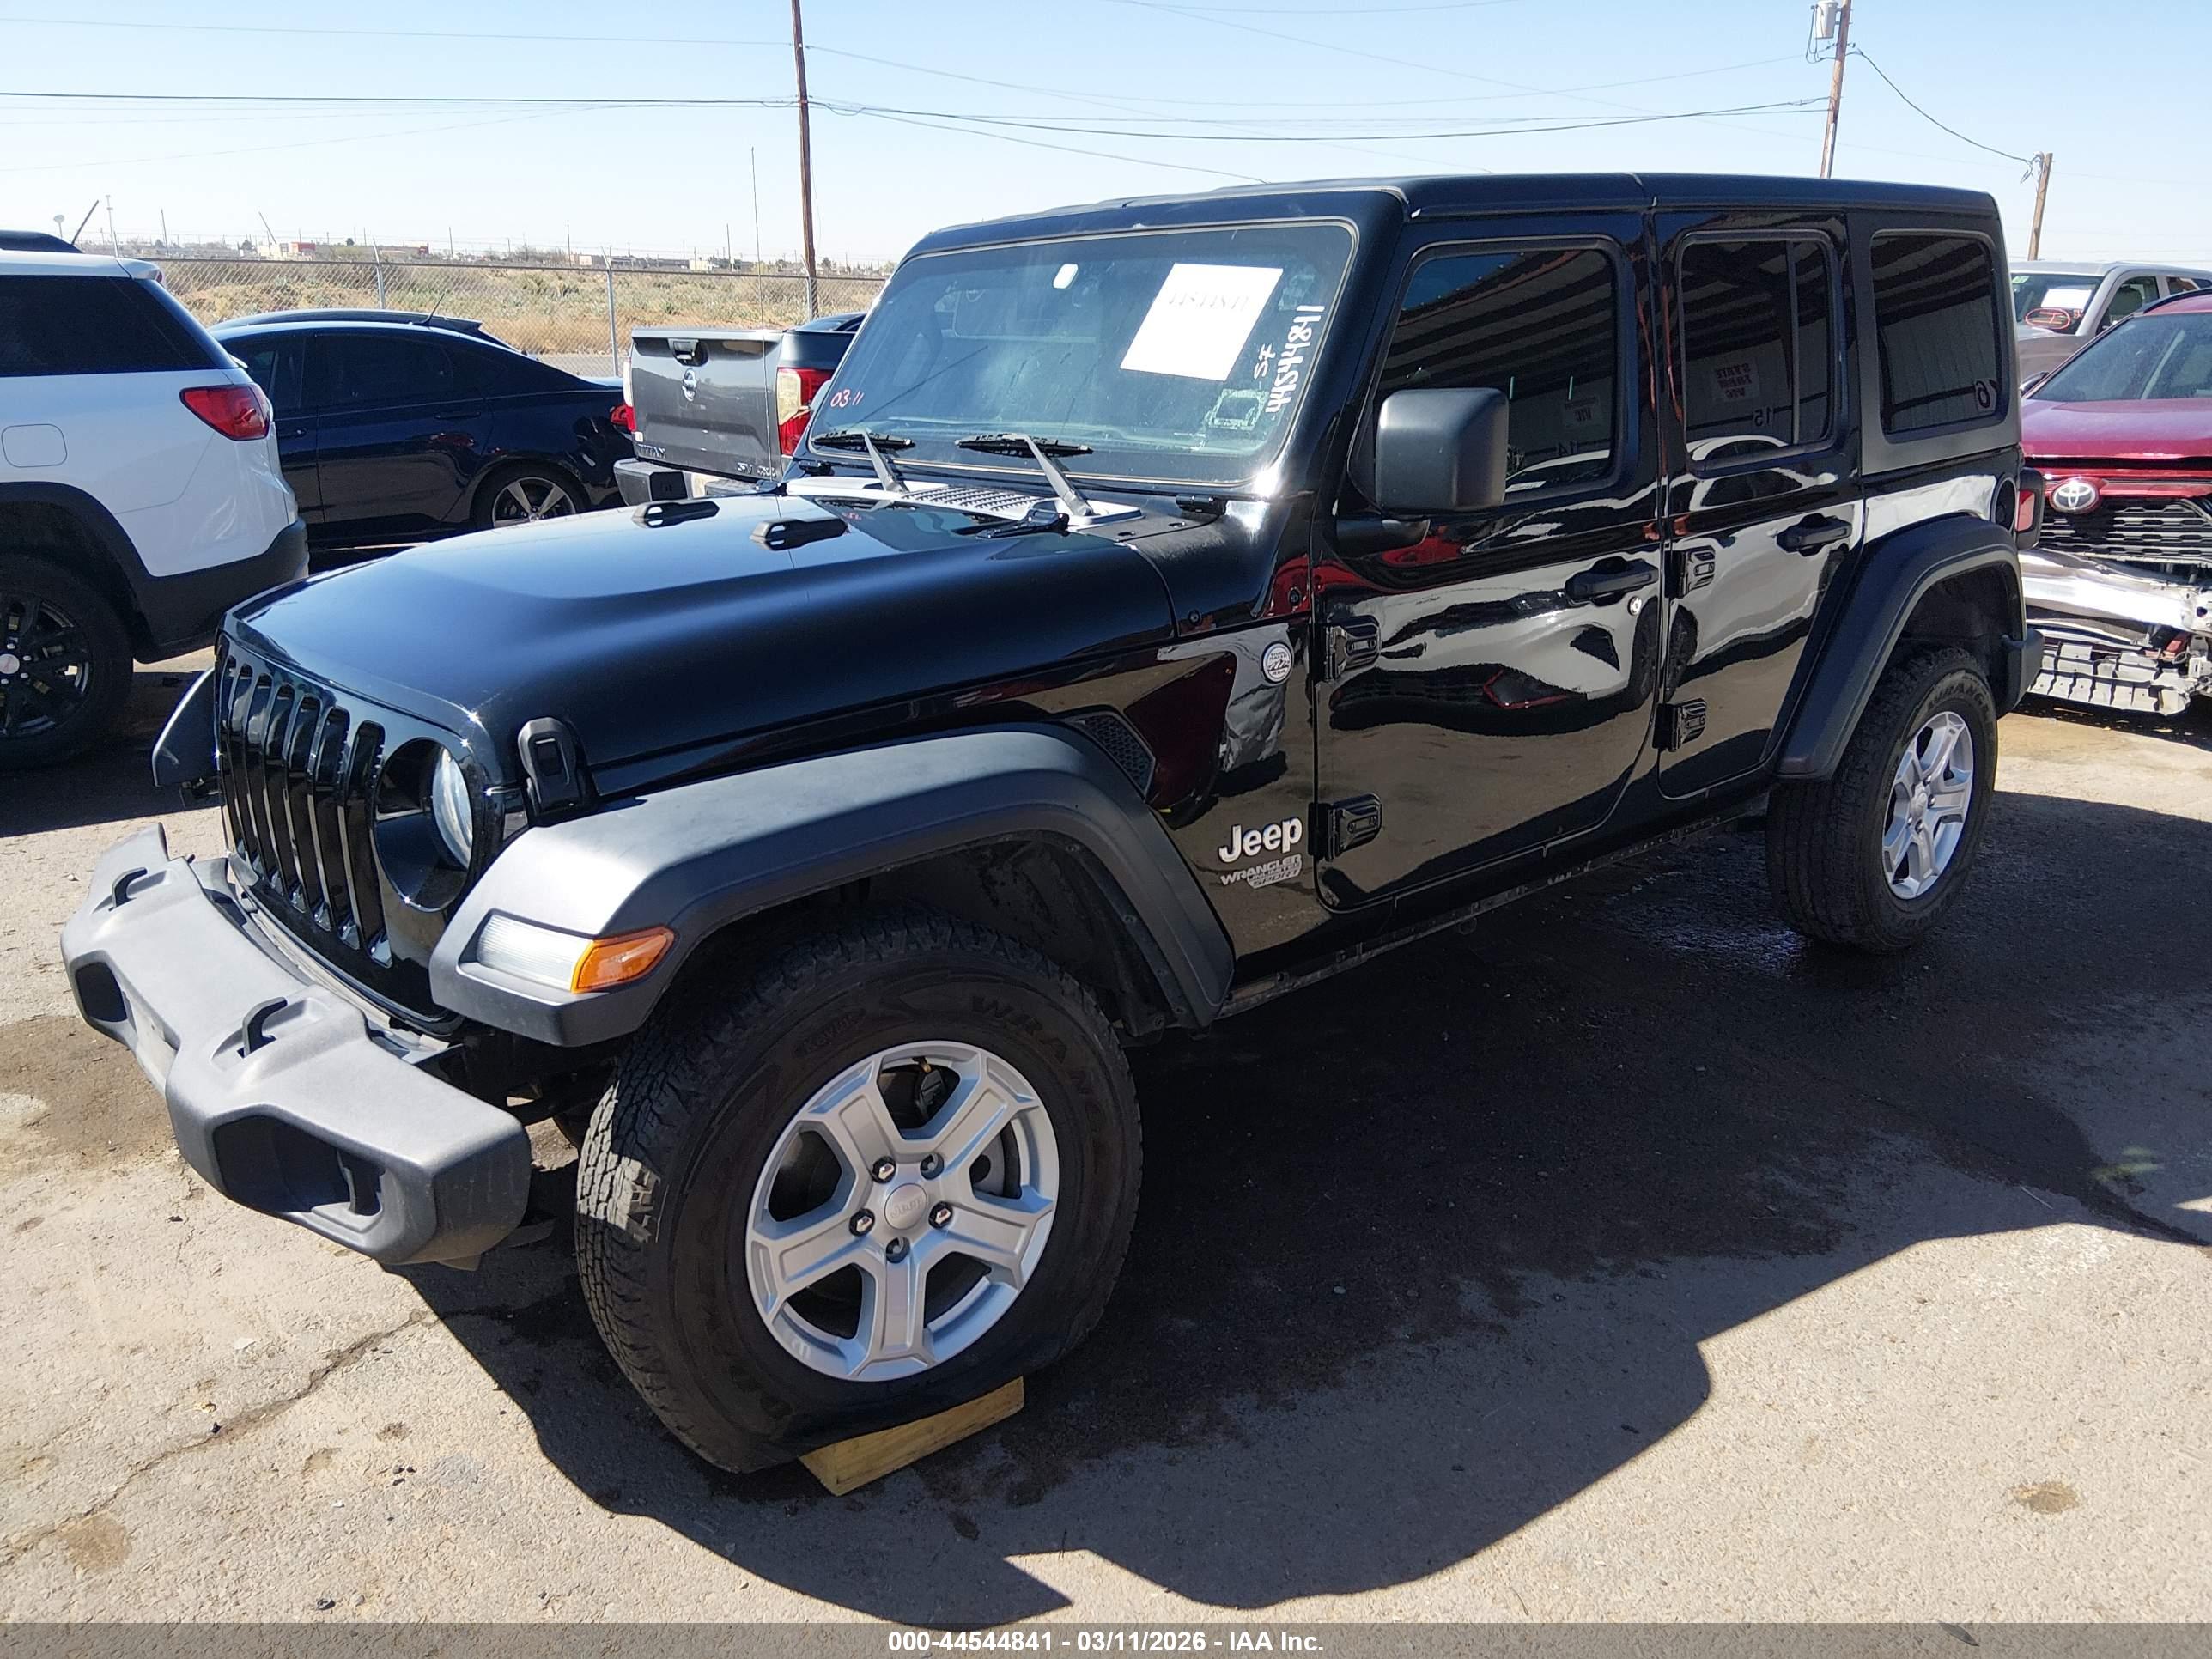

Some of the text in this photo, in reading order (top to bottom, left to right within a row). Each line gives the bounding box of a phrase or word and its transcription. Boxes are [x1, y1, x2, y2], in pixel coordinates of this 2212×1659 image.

[1254, 343, 1276, 380] SF
[1265, 305, 1325, 413] 44544841
[1218, 817, 1303, 863] Jeep
[1220, 854, 1302, 886] WRANGLER
